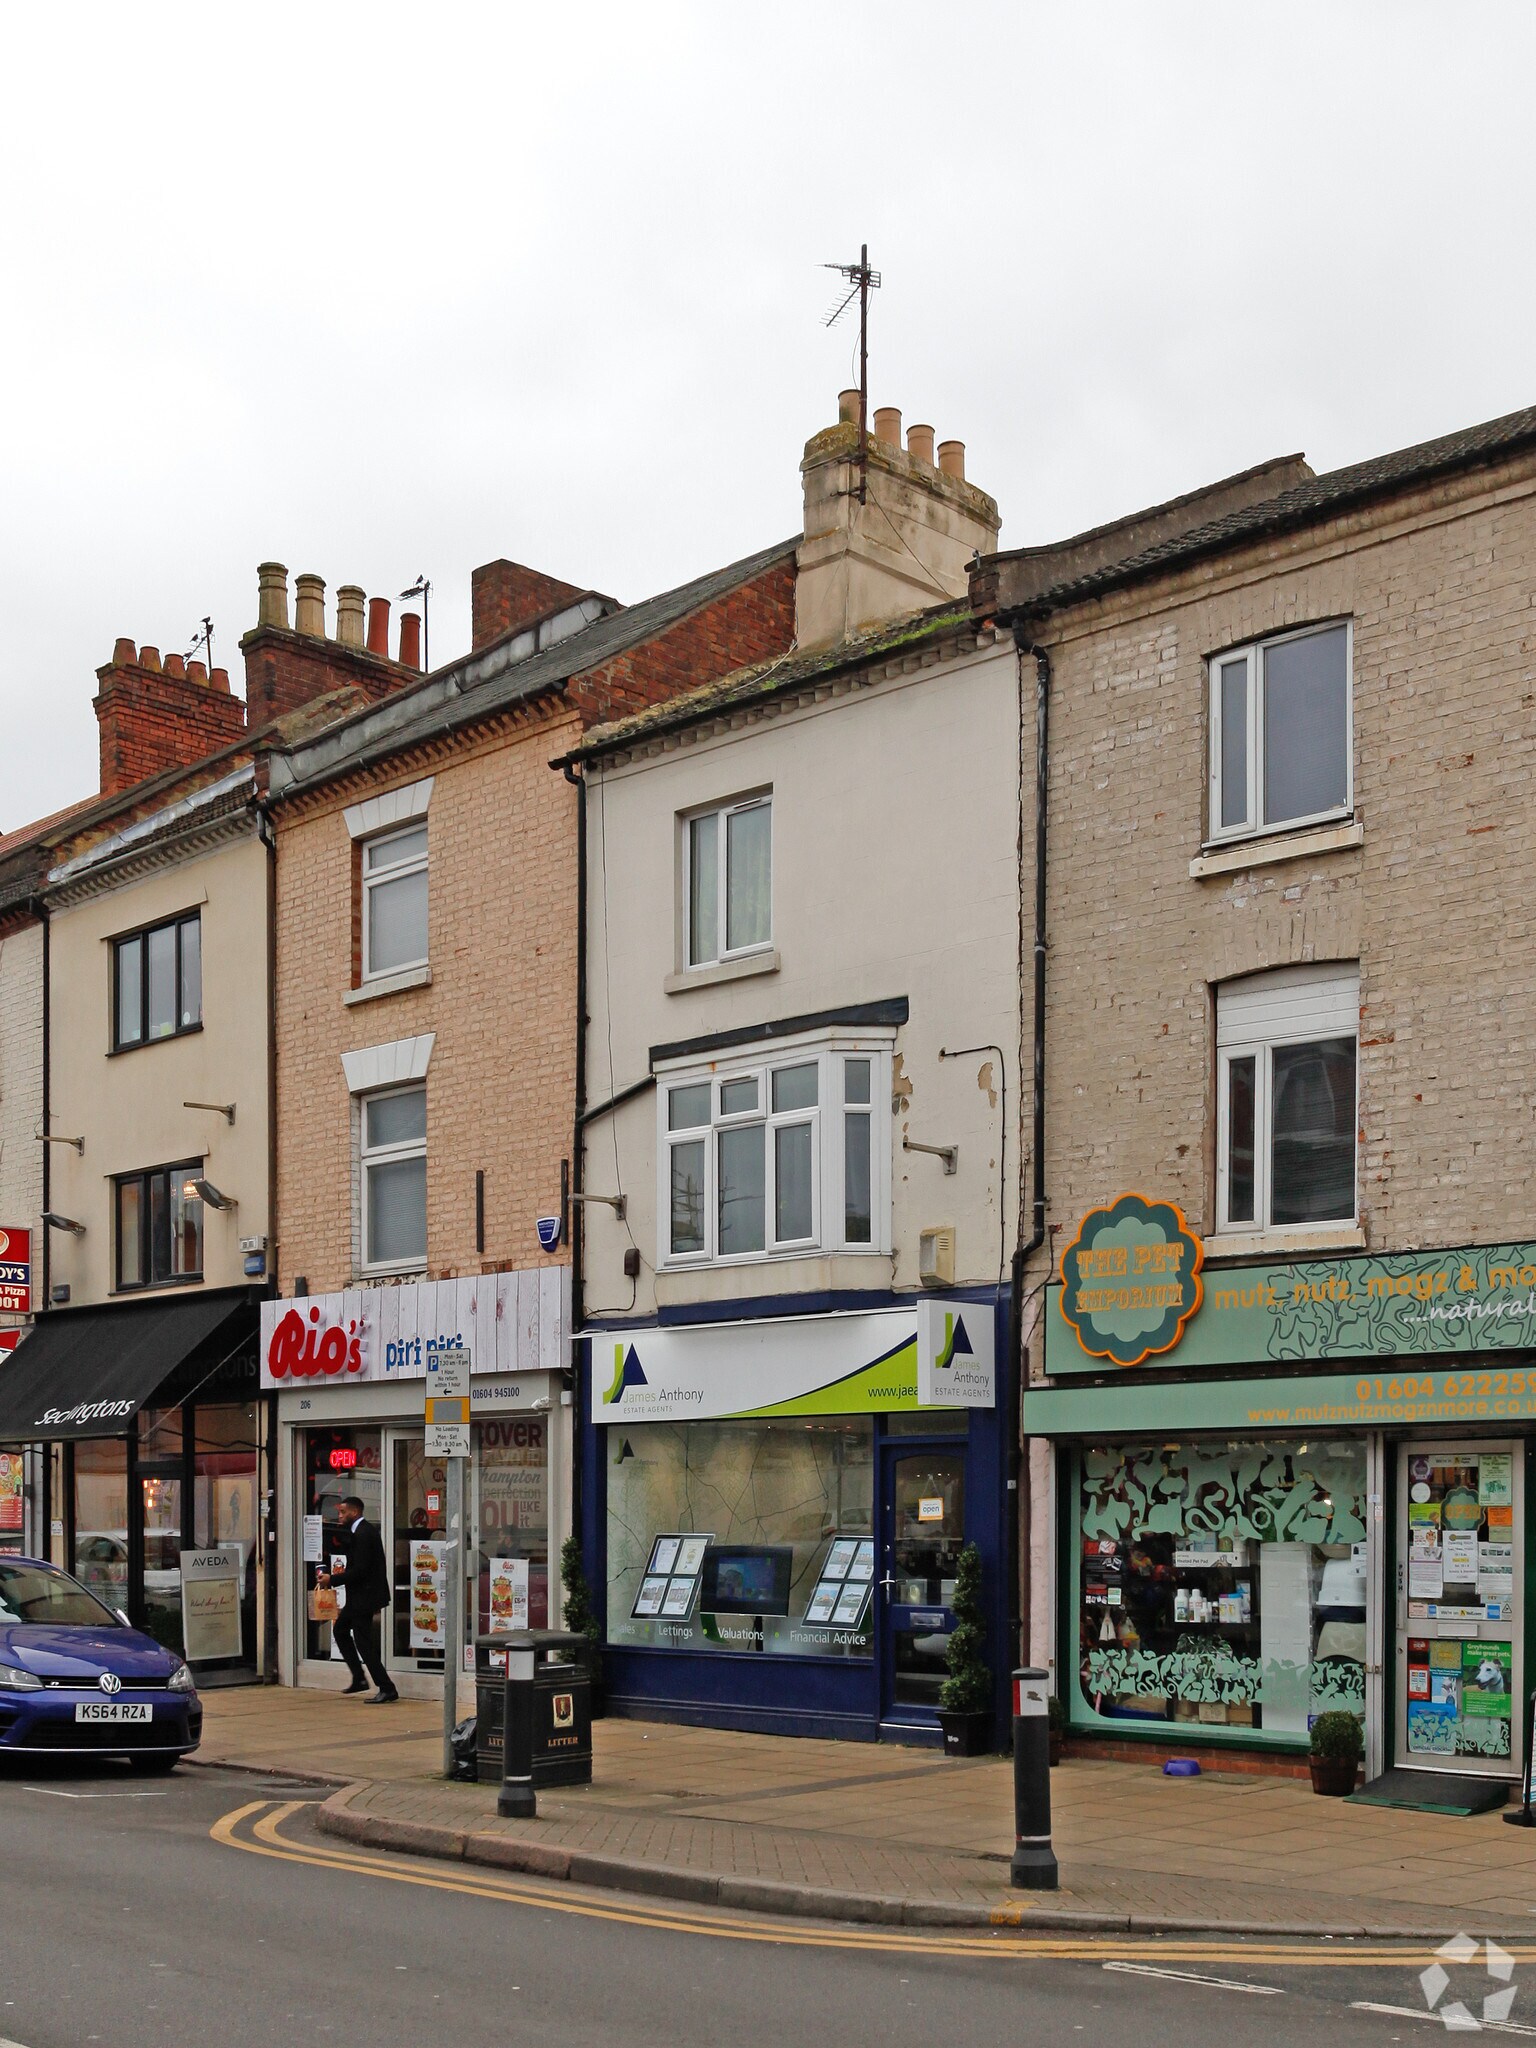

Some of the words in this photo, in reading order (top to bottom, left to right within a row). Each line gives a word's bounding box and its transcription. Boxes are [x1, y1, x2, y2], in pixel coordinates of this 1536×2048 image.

[1076, 1247, 1127, 1279] THE
[1132, 1242, 1184, 1275] PET
[4, 1286, 26, 1297] Pizza
[1215, 1281, 1285, 1310] mutz,
[1294, 1275, 1357, 1304] nutz,
[1367, 1270, 1449, 1301] mogz
[1459, 1265, 1477, 1291] &
[1075, 1283, 1184, 1313] EMPORIUM
[268, 1306, 363, 1379] Rio's
[386, 1337, 422, 1372] piri
[954, 1359, 981, 1371] James
[954, 1371, 990, 1387] Anthony
[472, 1388, 492, 1399] 01604
[494, 1387, 520, 1399] 945100
[935, 1387, 961, 1397] ESTATE
[962, 1388, 991, 1398] AGENTS
[1356, 1377, 1435, 1400] 01604
[623, 1391, 656, 1404] James
[659, 1387, 704, 1403] Anthony
[300, 1400, 312, 1410] 206
[623, 1406, 646, 1415] ESTATE
[648, 1405, 673, 1413] AGENTS
[330, 1450, 357, 1468] OPEN
[483, 1488, 541, 1499] perfection
[922, 1506, 940, 1514] open
[192, 1556, 229, 1567] AVEDA
[617, 1622, 636, 1634] ales
[658, 1624, 693, 1638] Lettings
[718, 1627, 764, 1641] Valuations
[790, 1630, 830, 1645] Financial
[833, 1631, 866, 1646] Advice
[1466, 1643, 1500, 1651] Greyhounds
[82, 1705, 118, 1719] KS64
[121, 1705, 147, 1719] RZA
[547, 1736, 579, 1748] LITTER
